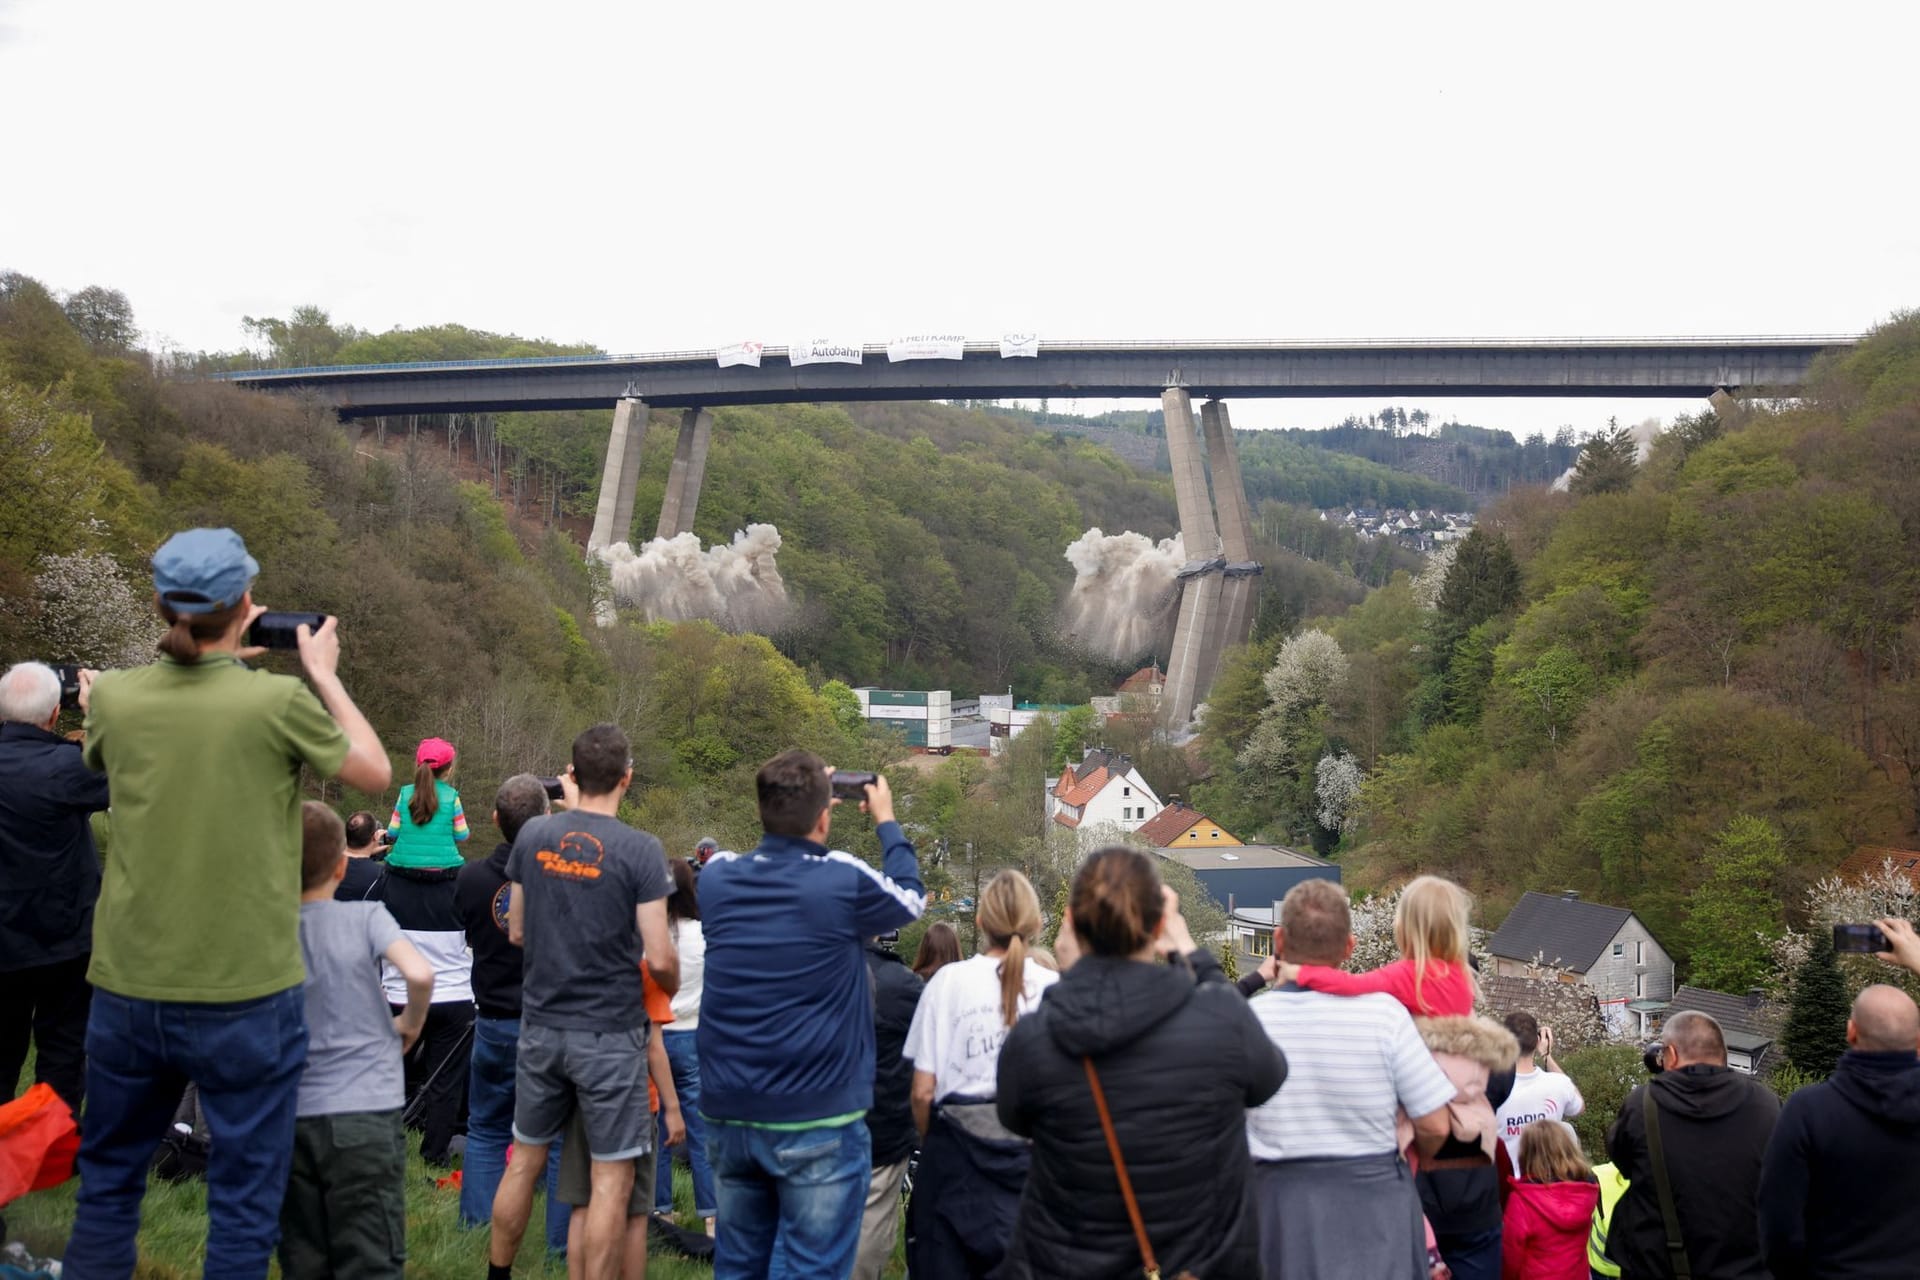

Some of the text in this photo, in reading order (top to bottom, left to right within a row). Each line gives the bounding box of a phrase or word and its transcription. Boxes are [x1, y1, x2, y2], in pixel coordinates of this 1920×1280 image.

[906, 335, 965, 343] HEITKAMP
[811, 345, 860, 358] Autobahn
[1506, 1113, 1546, 1126] RADIO
